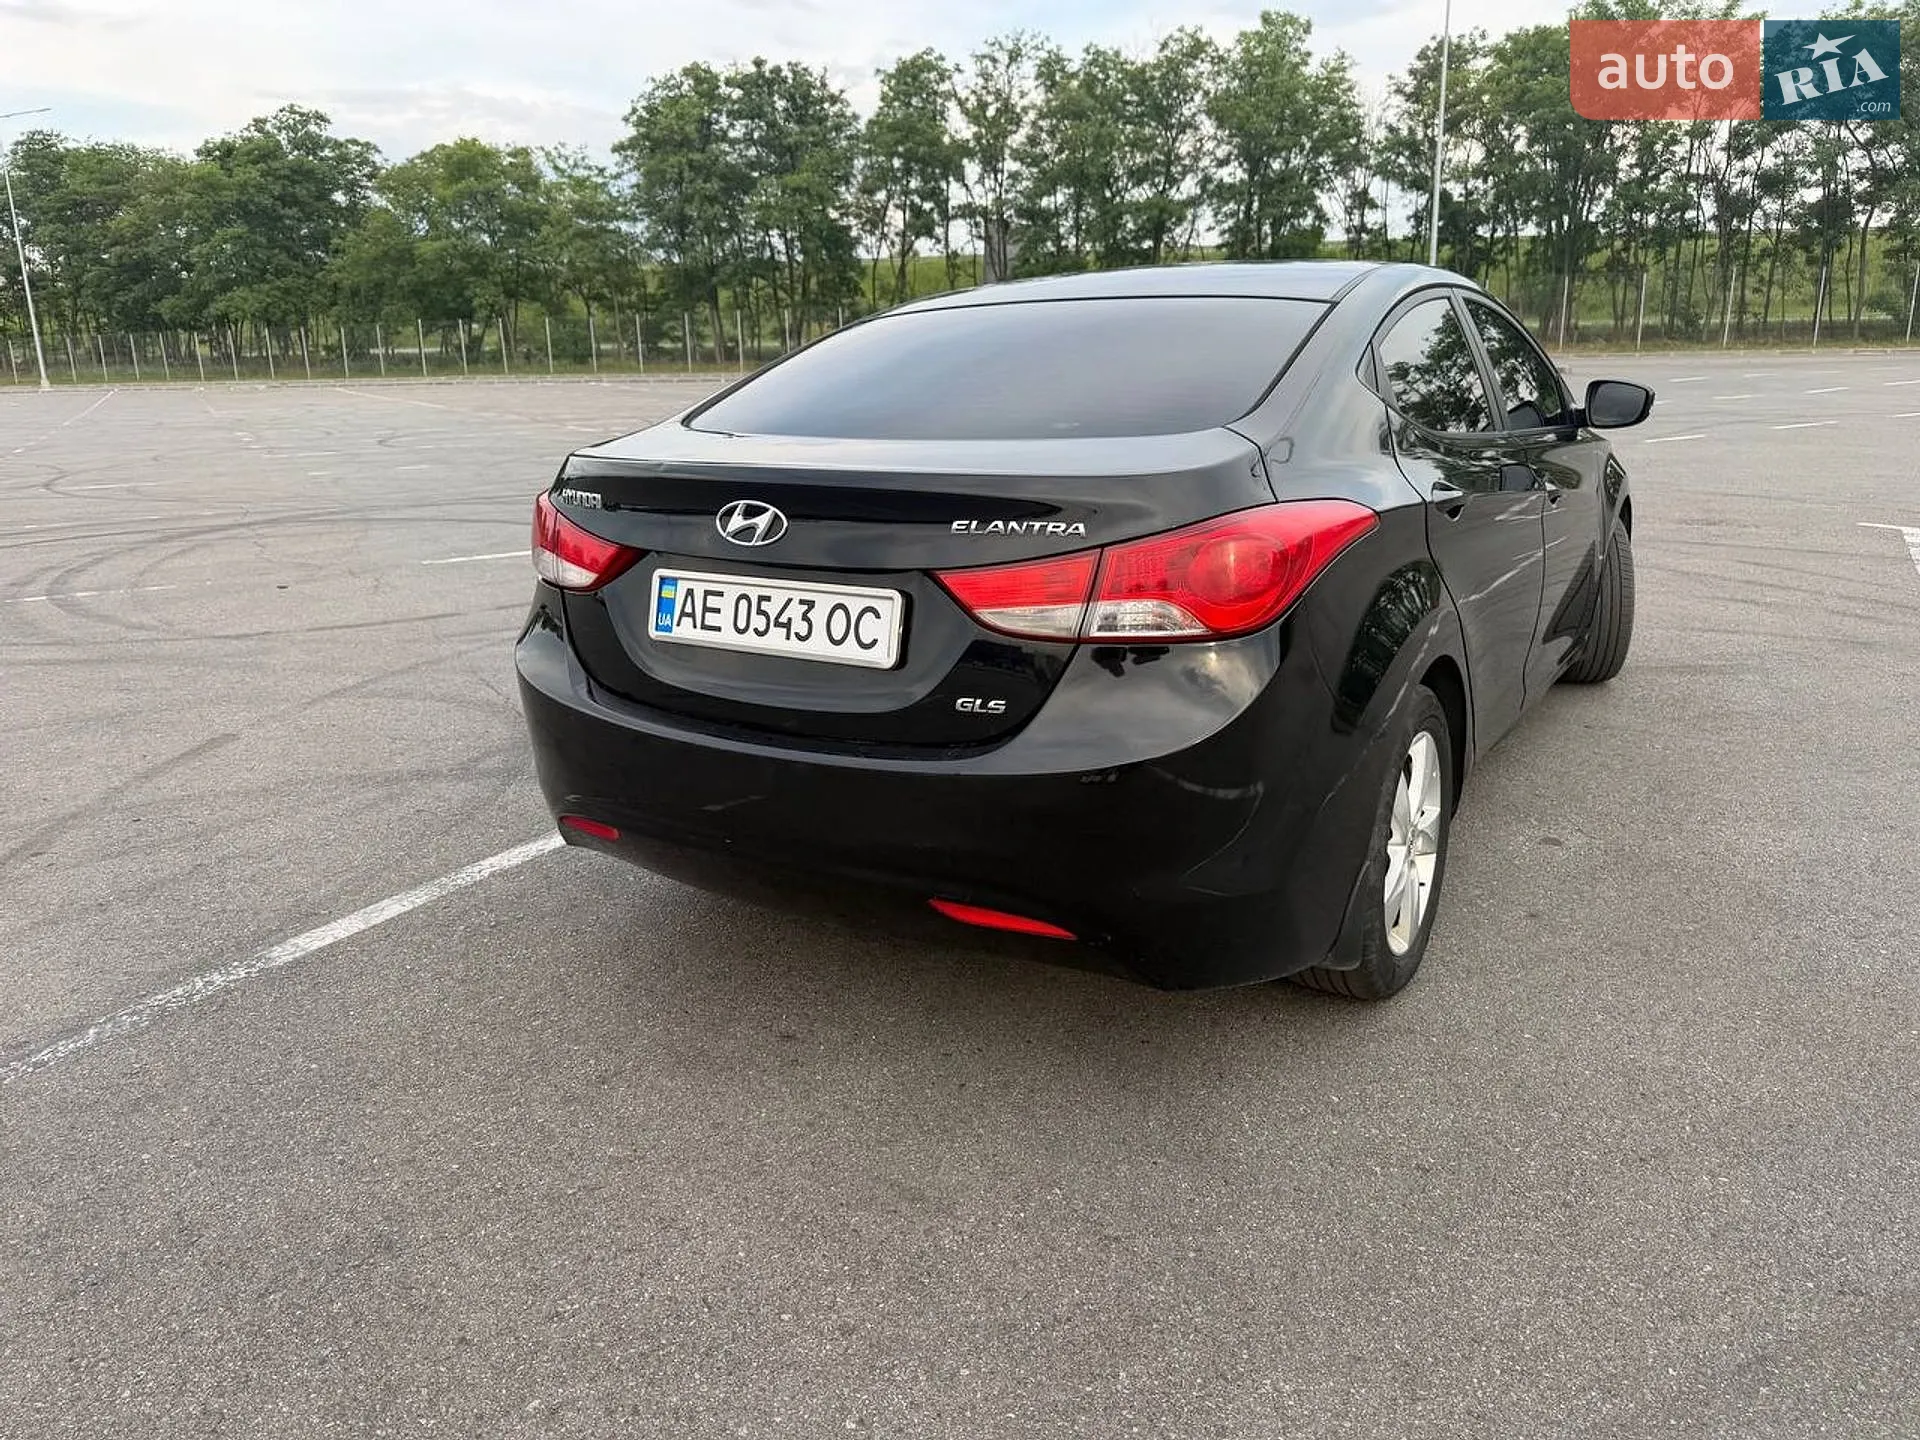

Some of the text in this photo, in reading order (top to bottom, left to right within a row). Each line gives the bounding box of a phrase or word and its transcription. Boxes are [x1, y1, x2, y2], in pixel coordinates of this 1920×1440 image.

[950, 520, 1086, 537] ELANTRA
[658, 612, 672, 627] UA
[676, 587, 881, 650] AE 0543 OC
[955, 698, 1006, 713] GLS
